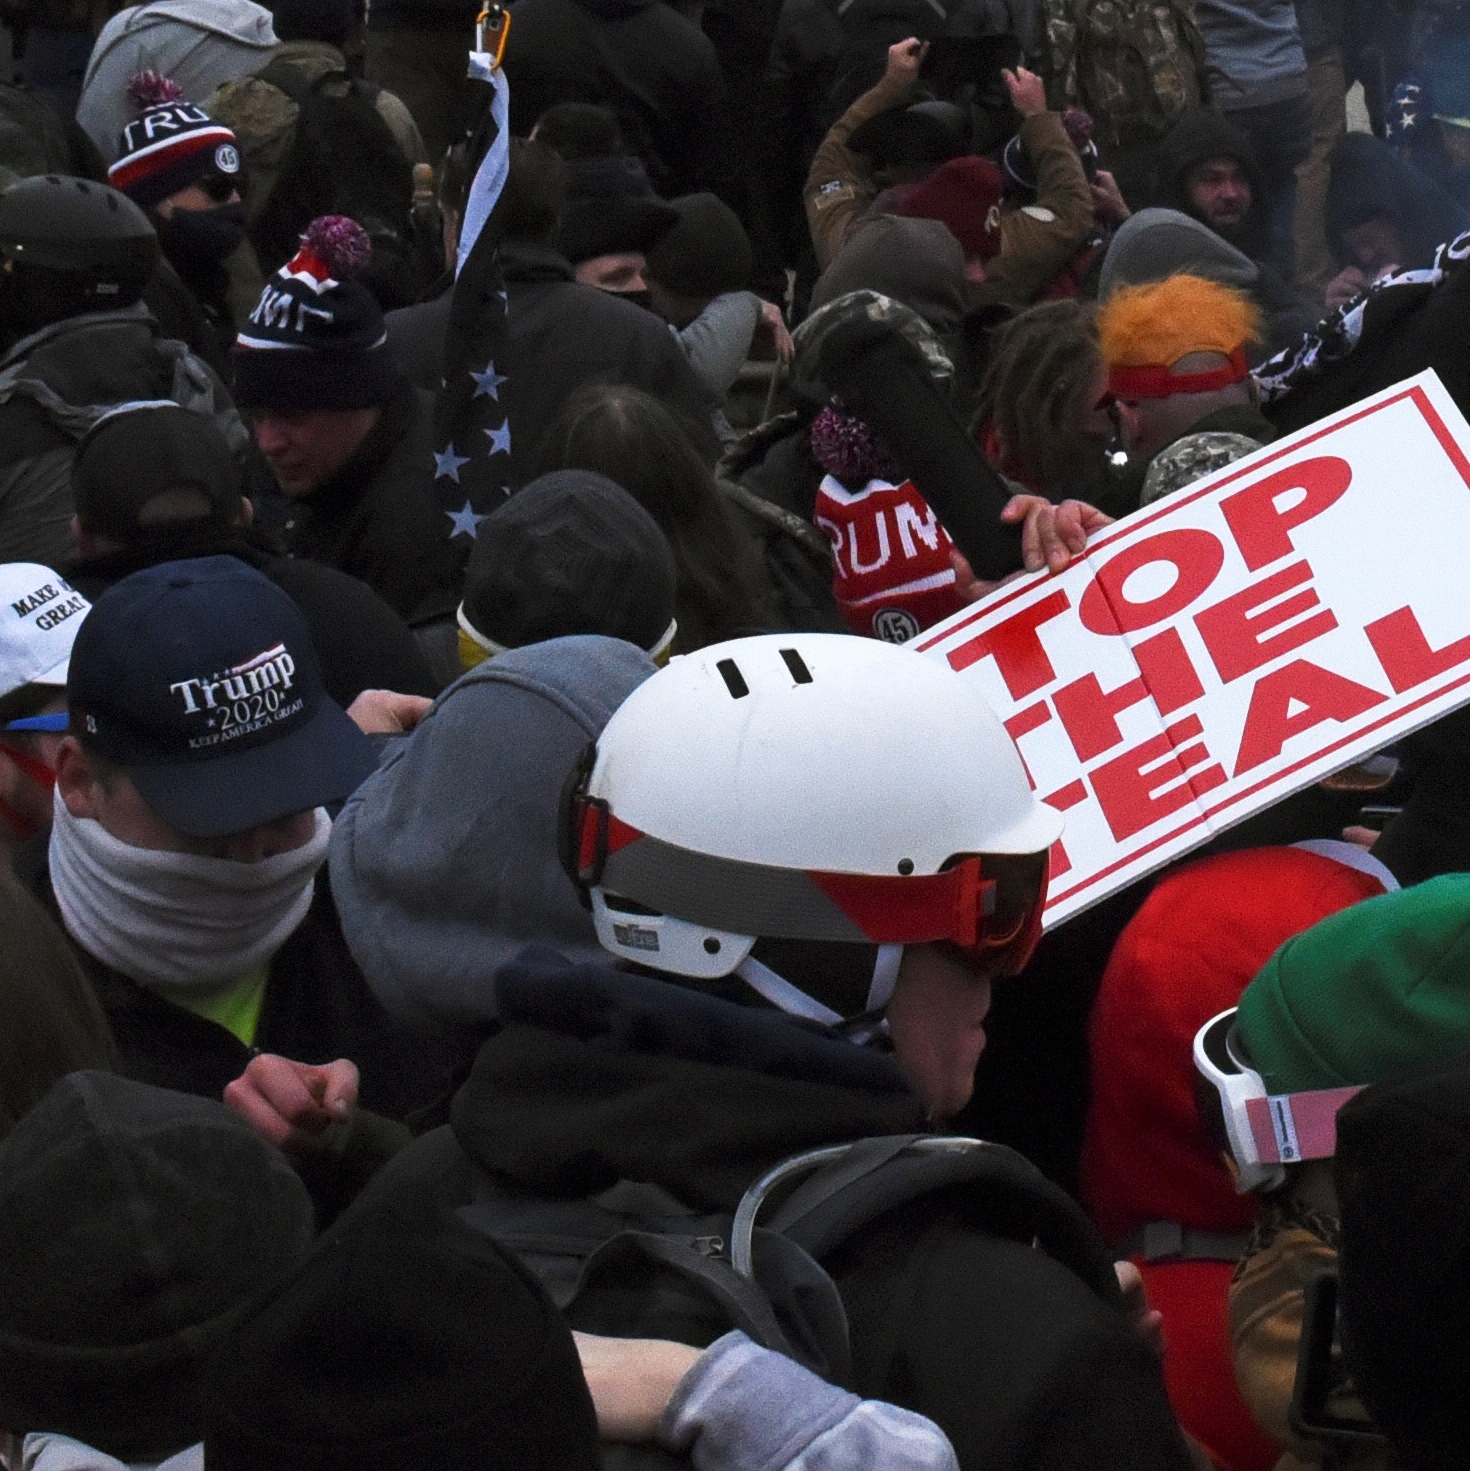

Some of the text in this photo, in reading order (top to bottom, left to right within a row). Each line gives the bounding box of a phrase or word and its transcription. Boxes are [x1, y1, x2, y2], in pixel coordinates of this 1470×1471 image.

[11, 584, 60, 618] MAKE
[947, 455, 1352, 703] TOP
[882, 615, 910, 643] 45
[169, 653, 296, 715] Trump
[216, 688, 280, 732] 2020
